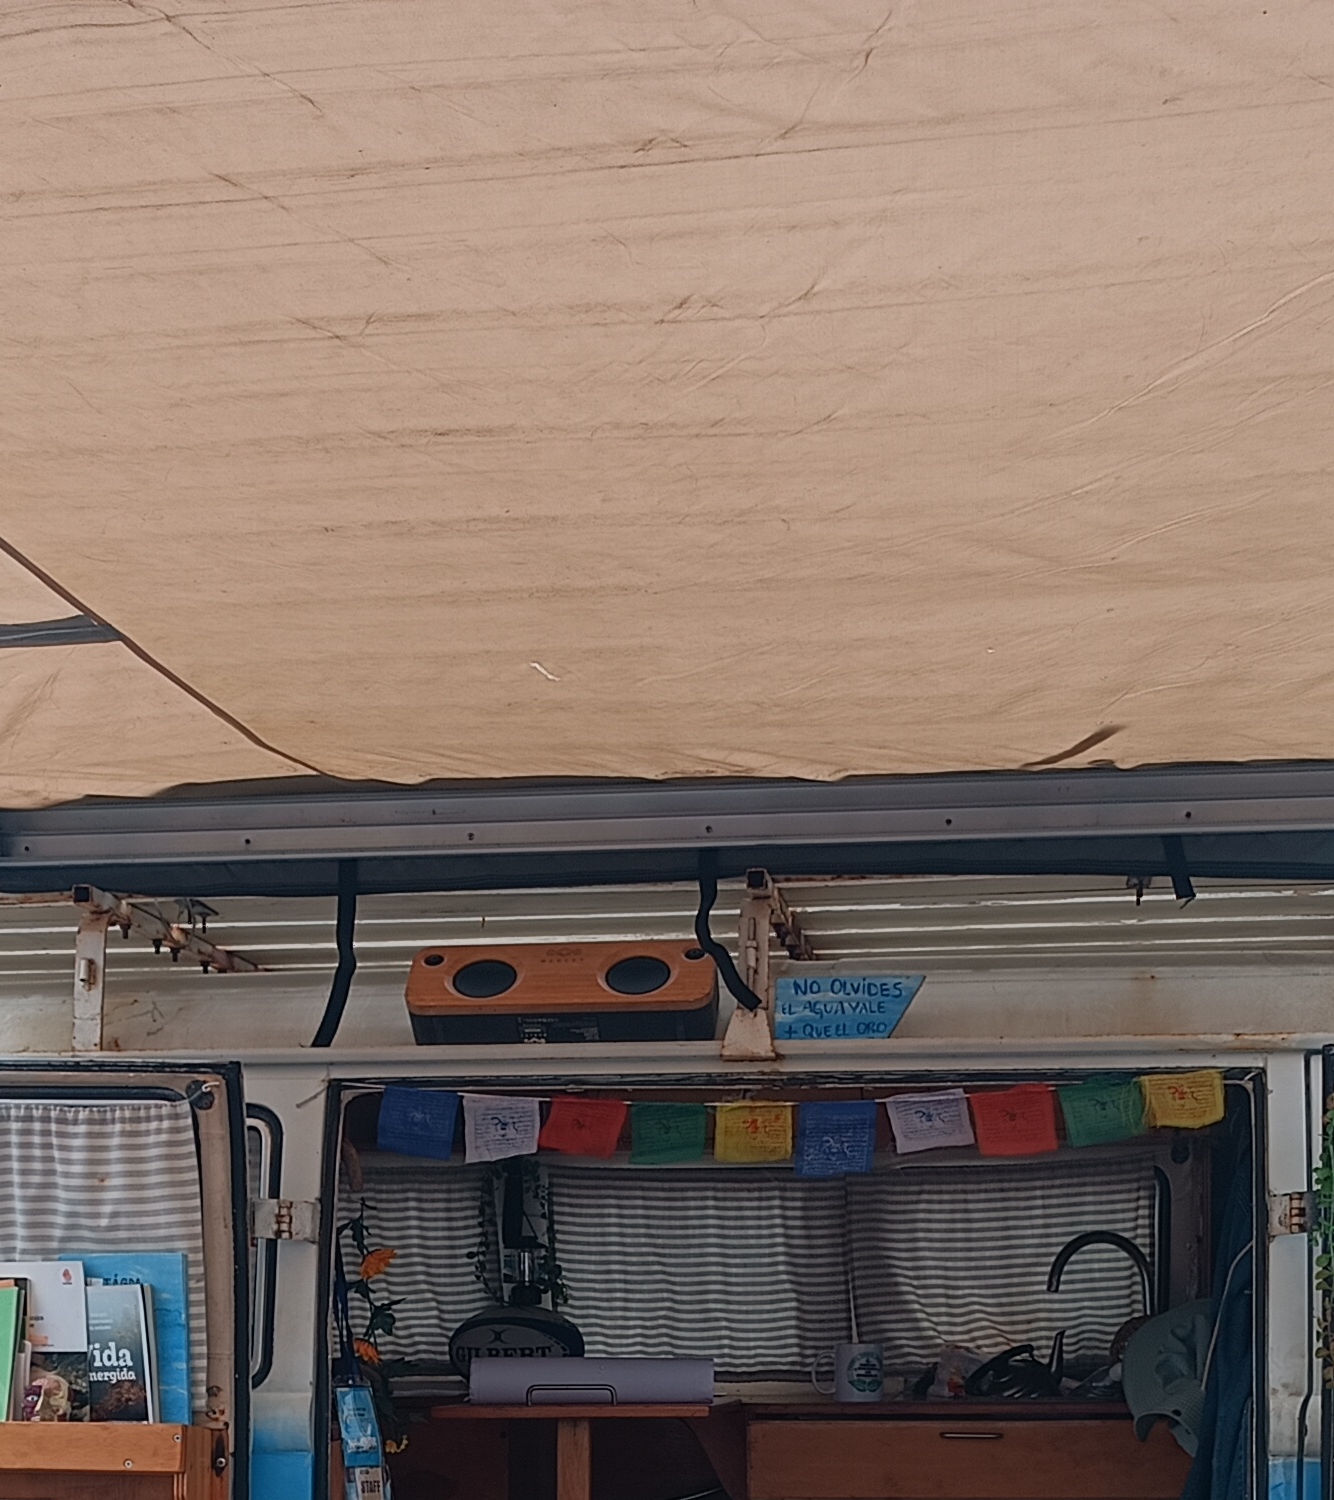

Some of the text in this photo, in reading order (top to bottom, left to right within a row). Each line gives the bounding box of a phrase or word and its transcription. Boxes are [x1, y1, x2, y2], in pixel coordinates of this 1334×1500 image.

[794, 978, 821, 996] NO
[782, 1003, 796, 1016] EL
[803, 1023, 831, 1038] QUE
[835, 1022, 851, 1037] EL
[857, 1021, 887, 1034] ORO
[360, 1480, 382, 1494] STAFF
